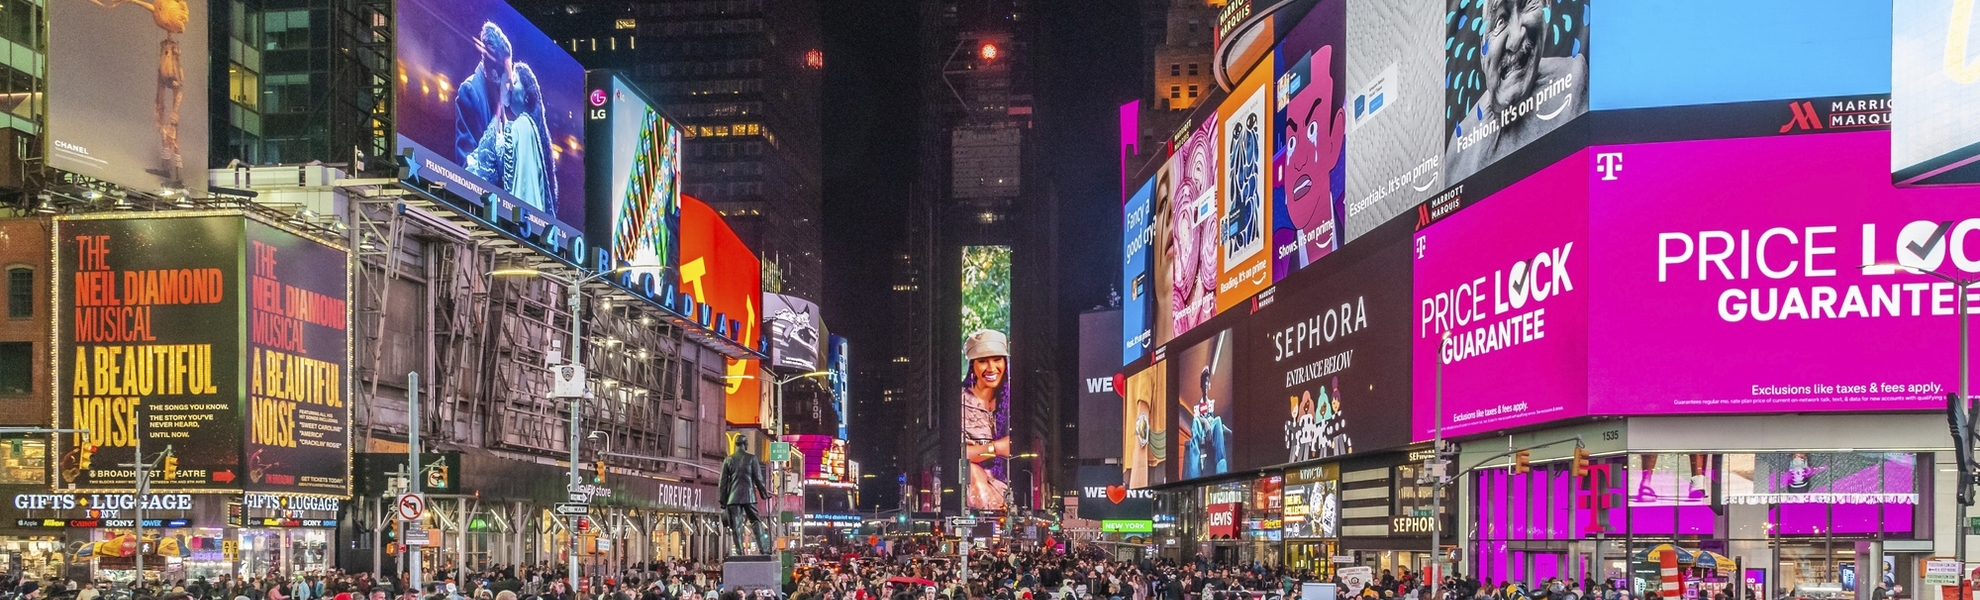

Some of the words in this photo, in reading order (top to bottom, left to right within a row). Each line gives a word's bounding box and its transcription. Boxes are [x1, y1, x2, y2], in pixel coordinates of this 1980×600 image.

[1220, 4, 1250, 40] MARQUIS
[591, 109, 606, 120] LG
[1456, 120, 1500, 153] Fashion.
[1500, 105, 1518, 127] It's
[1518, 99, 1534, 116] on
[1536, 73, 1573, 112] prime
[54, 139, 89, 155] CHANEL
[1349, 189, 1387, 218] Essentials.
[1388, 177, 1401, 194] It's
[1401, 171, 1412, 185] on
[1412, 153, 1439, 185] prime
[1431, 184, 1465, 208] MARRIOTT
[1126, 203, 1145, 232] Fancy
[1145, 198, 1150, 215] a
[1431, 198, 1460, 220] MARQUIS
[75, 235, 111, 271] THE
[1126, 228, 1142, 264] good
[1278, 239, 1298, 260] Shows.
[1307, 230, 1316, 243] on
[1315, 218, 1334, 240] prime
[1658, 226, 1837, 283] PRICE
[253, 240, 277, 280] THE
[489, 192, 586, 265] 1540
[597, 247, 742, 341] BROADWAY
[1252, 259, 1267, 278] prime
[75, 271, 121, 307] NEIL
[124, 268, 224, 306] DIAMOND
[252, 275, 284, 316] NEIL
[285, 284, 346, 331] DIAMOND
[1421, 276, 1487, 339] PRICE
[1494, 241, 1574, 316] LOCK
[75, 305, 157, 343] MUSICAL
[252, 309, 307, 354] MUSICAL
[1274, 295, 1368, 362] SEPHORA
[1441, 308, 1545, 365] GUARANTEE
[73, 345, 90, 396] A
[94, 344, 217, 396] BEAUTIFUL
[251, 346, 263, 396] A
[265, 349, 343, 408] BEAUTIFUL
[1086, 376, 1113, 393] WE
[1286, 360, 1323, 389] ENTRANCE
[1323, 350, 1353, 376] BELOW
[1751, 384, 1812, 396] Exclusions
[1813, 384, 1834, 395] like
[1836, 383, 1867, 394] taxes
[1869, 382, 1878, 393] &
[1880, 382, 1905, 393] fees
[1907, 382, 1944, 395] apply.
[73, 396, 141, 448] NOISE
[251, 396, 297, 448] NOISE
[1453, 413, 1476, 423] Exclusions
[1476, 411, 1484, 420] like
[1484, 408, 1497, 417] taxes
[1497, 405, 1502, 414] &
[1502, 404, 1512, 413] fees
[1513, 401, 1529, 412] apply.
[1602, 430, 1619, 441] 1535
[97, 470, 161, 478] BROADHST
[595, 486, 611, 497] store
[14, 494, 76, 510] GIFTS
[244, 494, 280, 509] GIFTS
[288, 495, 339, 511] LUGGAGE
[658, 483, 692, 508] FOREVER
[694, 488, 702, 508] 21
[1084, 486, 1107, 499] WE
[43, 519, 65, 527] Nikon
[100, 510, 118, 519] NY
[292, 510, 304, 519] NY
